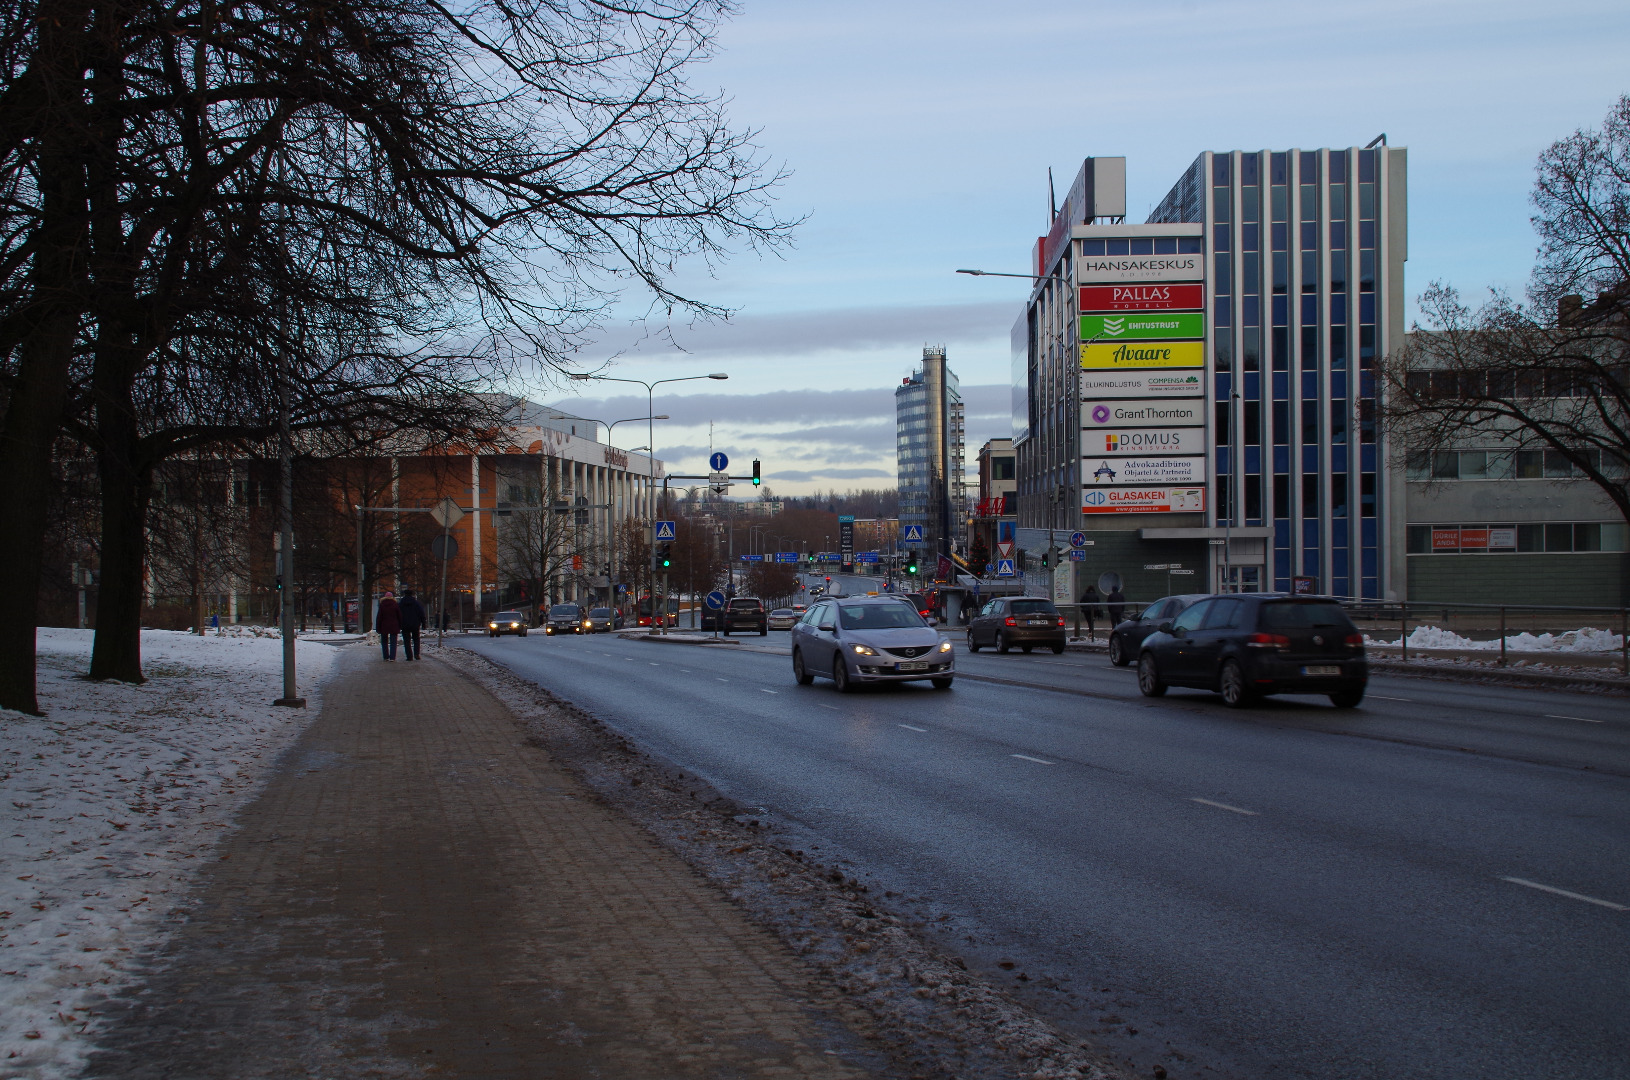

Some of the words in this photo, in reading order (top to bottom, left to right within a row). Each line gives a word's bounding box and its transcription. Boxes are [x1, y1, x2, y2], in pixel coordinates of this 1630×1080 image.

[1086, 260, 1194, 271] HANSAKESKUS
[1113, 287, 1170, 300] PALLAS
[1112, 344, 1171, 363] Avaare
[1120, 433, 1180, 445] DOMUS
[1109, 491, 1165, 500] GLASAKEN
